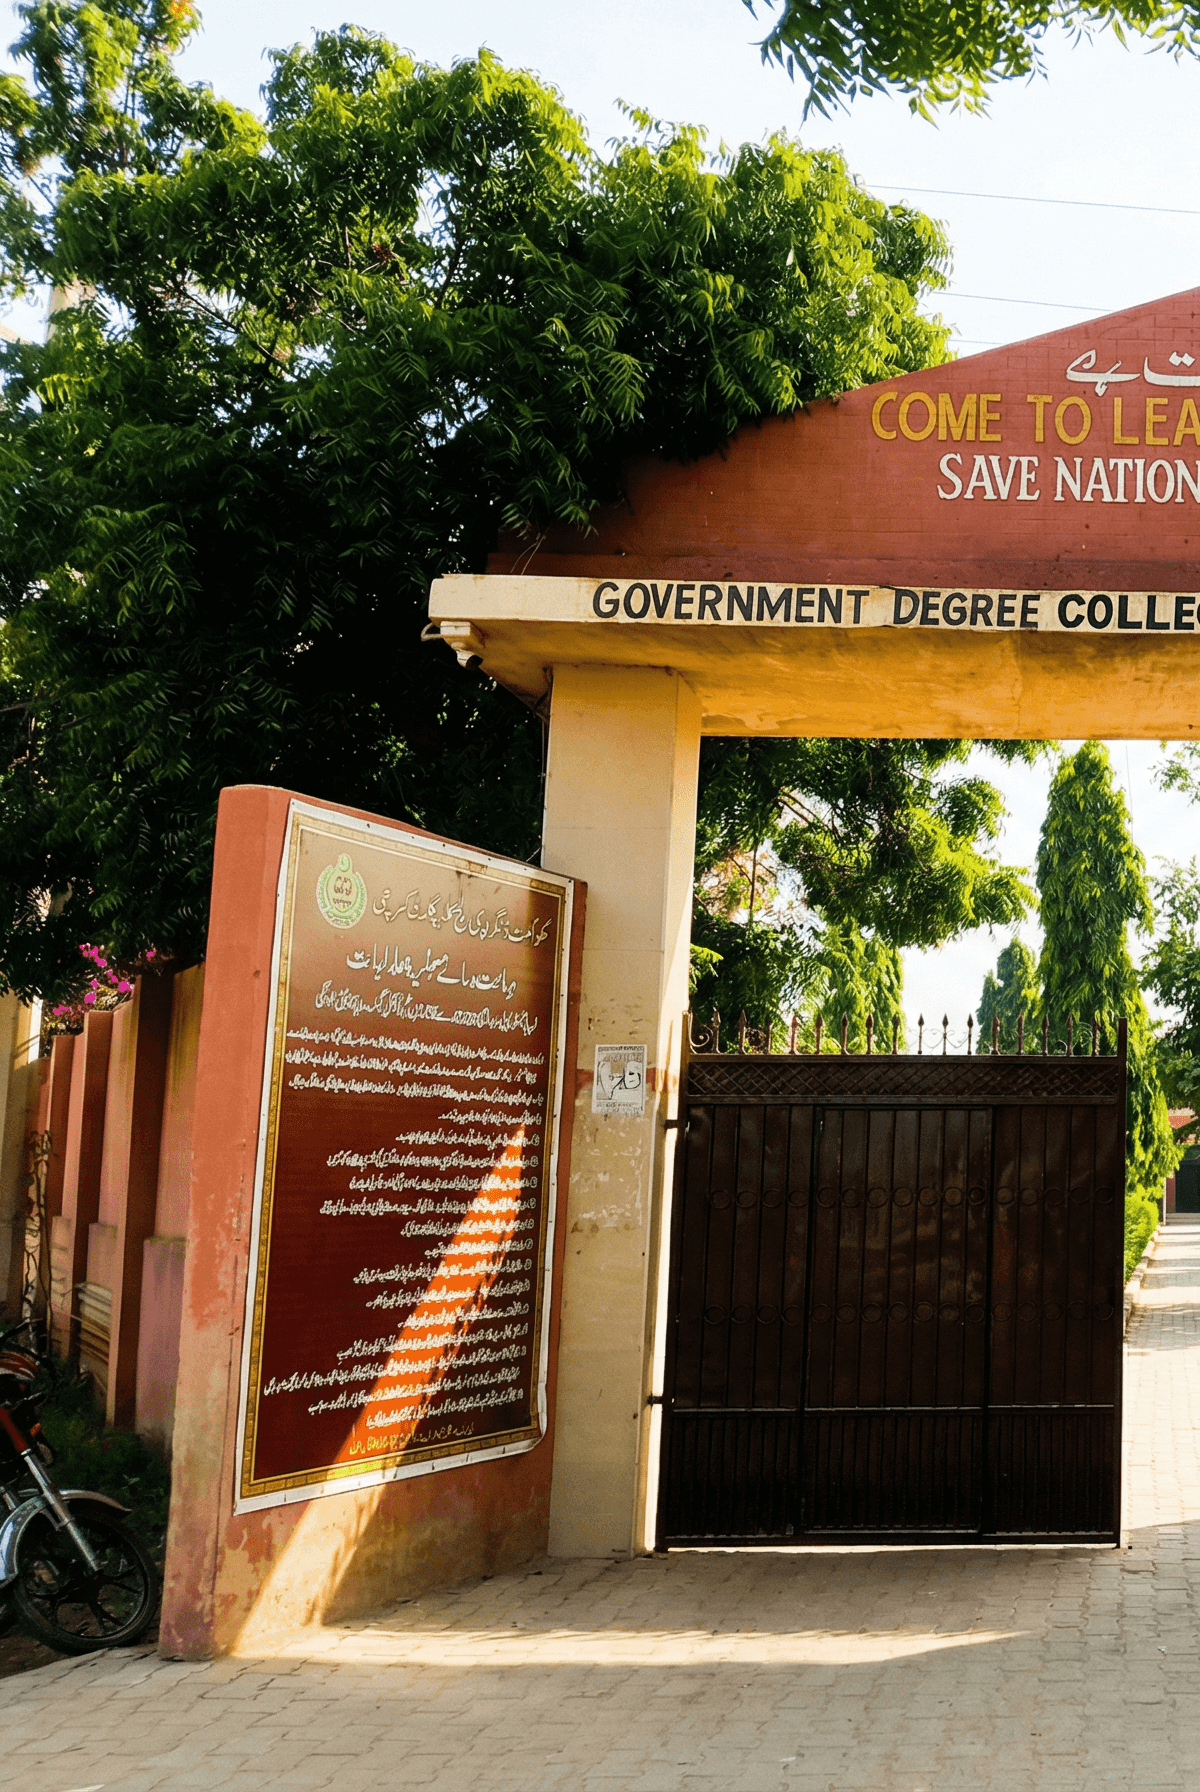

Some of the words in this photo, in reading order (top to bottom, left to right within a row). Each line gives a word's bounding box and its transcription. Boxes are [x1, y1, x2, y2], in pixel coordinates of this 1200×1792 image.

[871, 391, 1003, 443] COME
[1026, 394, 1092, 445] TO
[937, 452, 1042, 501] SAVE
[592, 581, 870, 624] GOVERNMENT
[893, 588, 1041, 628] DEGREE
